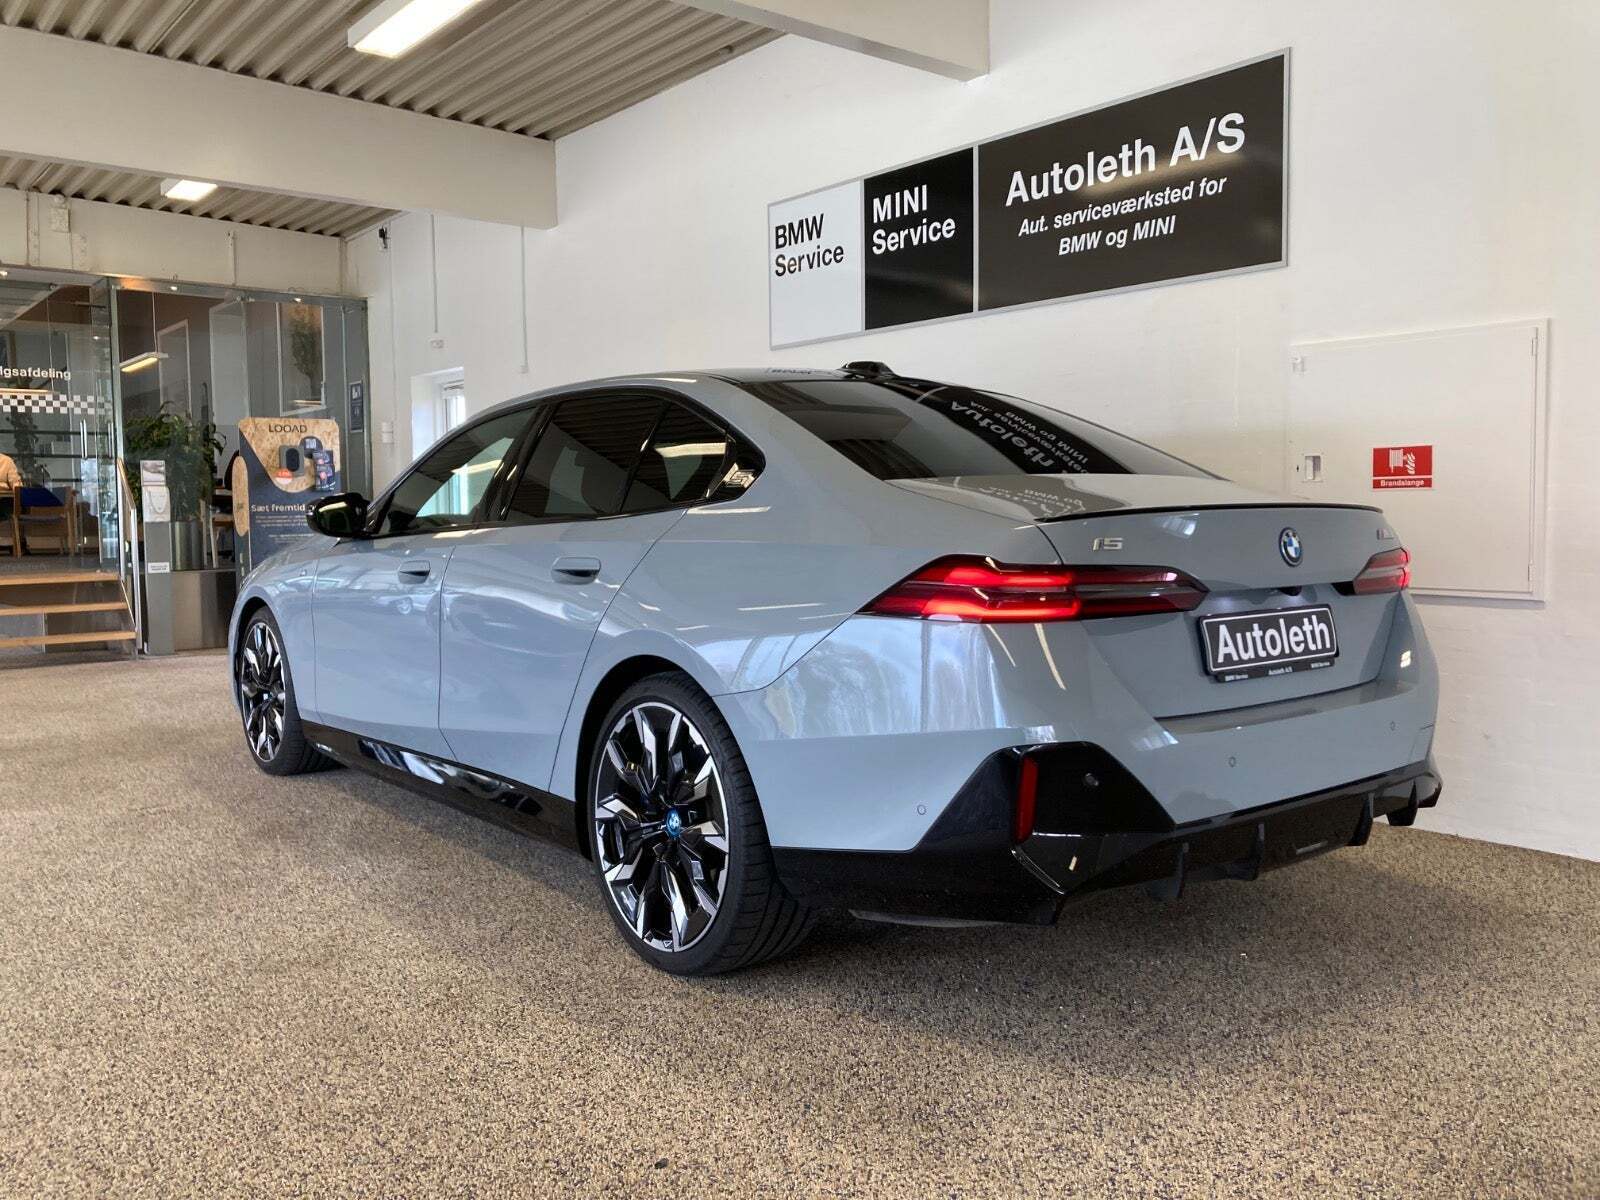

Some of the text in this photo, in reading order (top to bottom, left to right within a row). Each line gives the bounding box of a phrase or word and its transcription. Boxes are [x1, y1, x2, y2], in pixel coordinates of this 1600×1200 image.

[1005, 112, 1246, 207] Autoleth A/S
[872, 184, 928, 224] MINI
[1018, 177, 1228, 237] Aut. serviceværksted for
[775, 213, 825, 250] BMW
[872, 218, 957, 255] Service
[1058, 215, 1177, 256] BMW og MINI
[775, 245, 845, 277] Service
[1380, 479, 1425, 487] Brandslange
[1216, 614, 1332, 663] Autoleth
